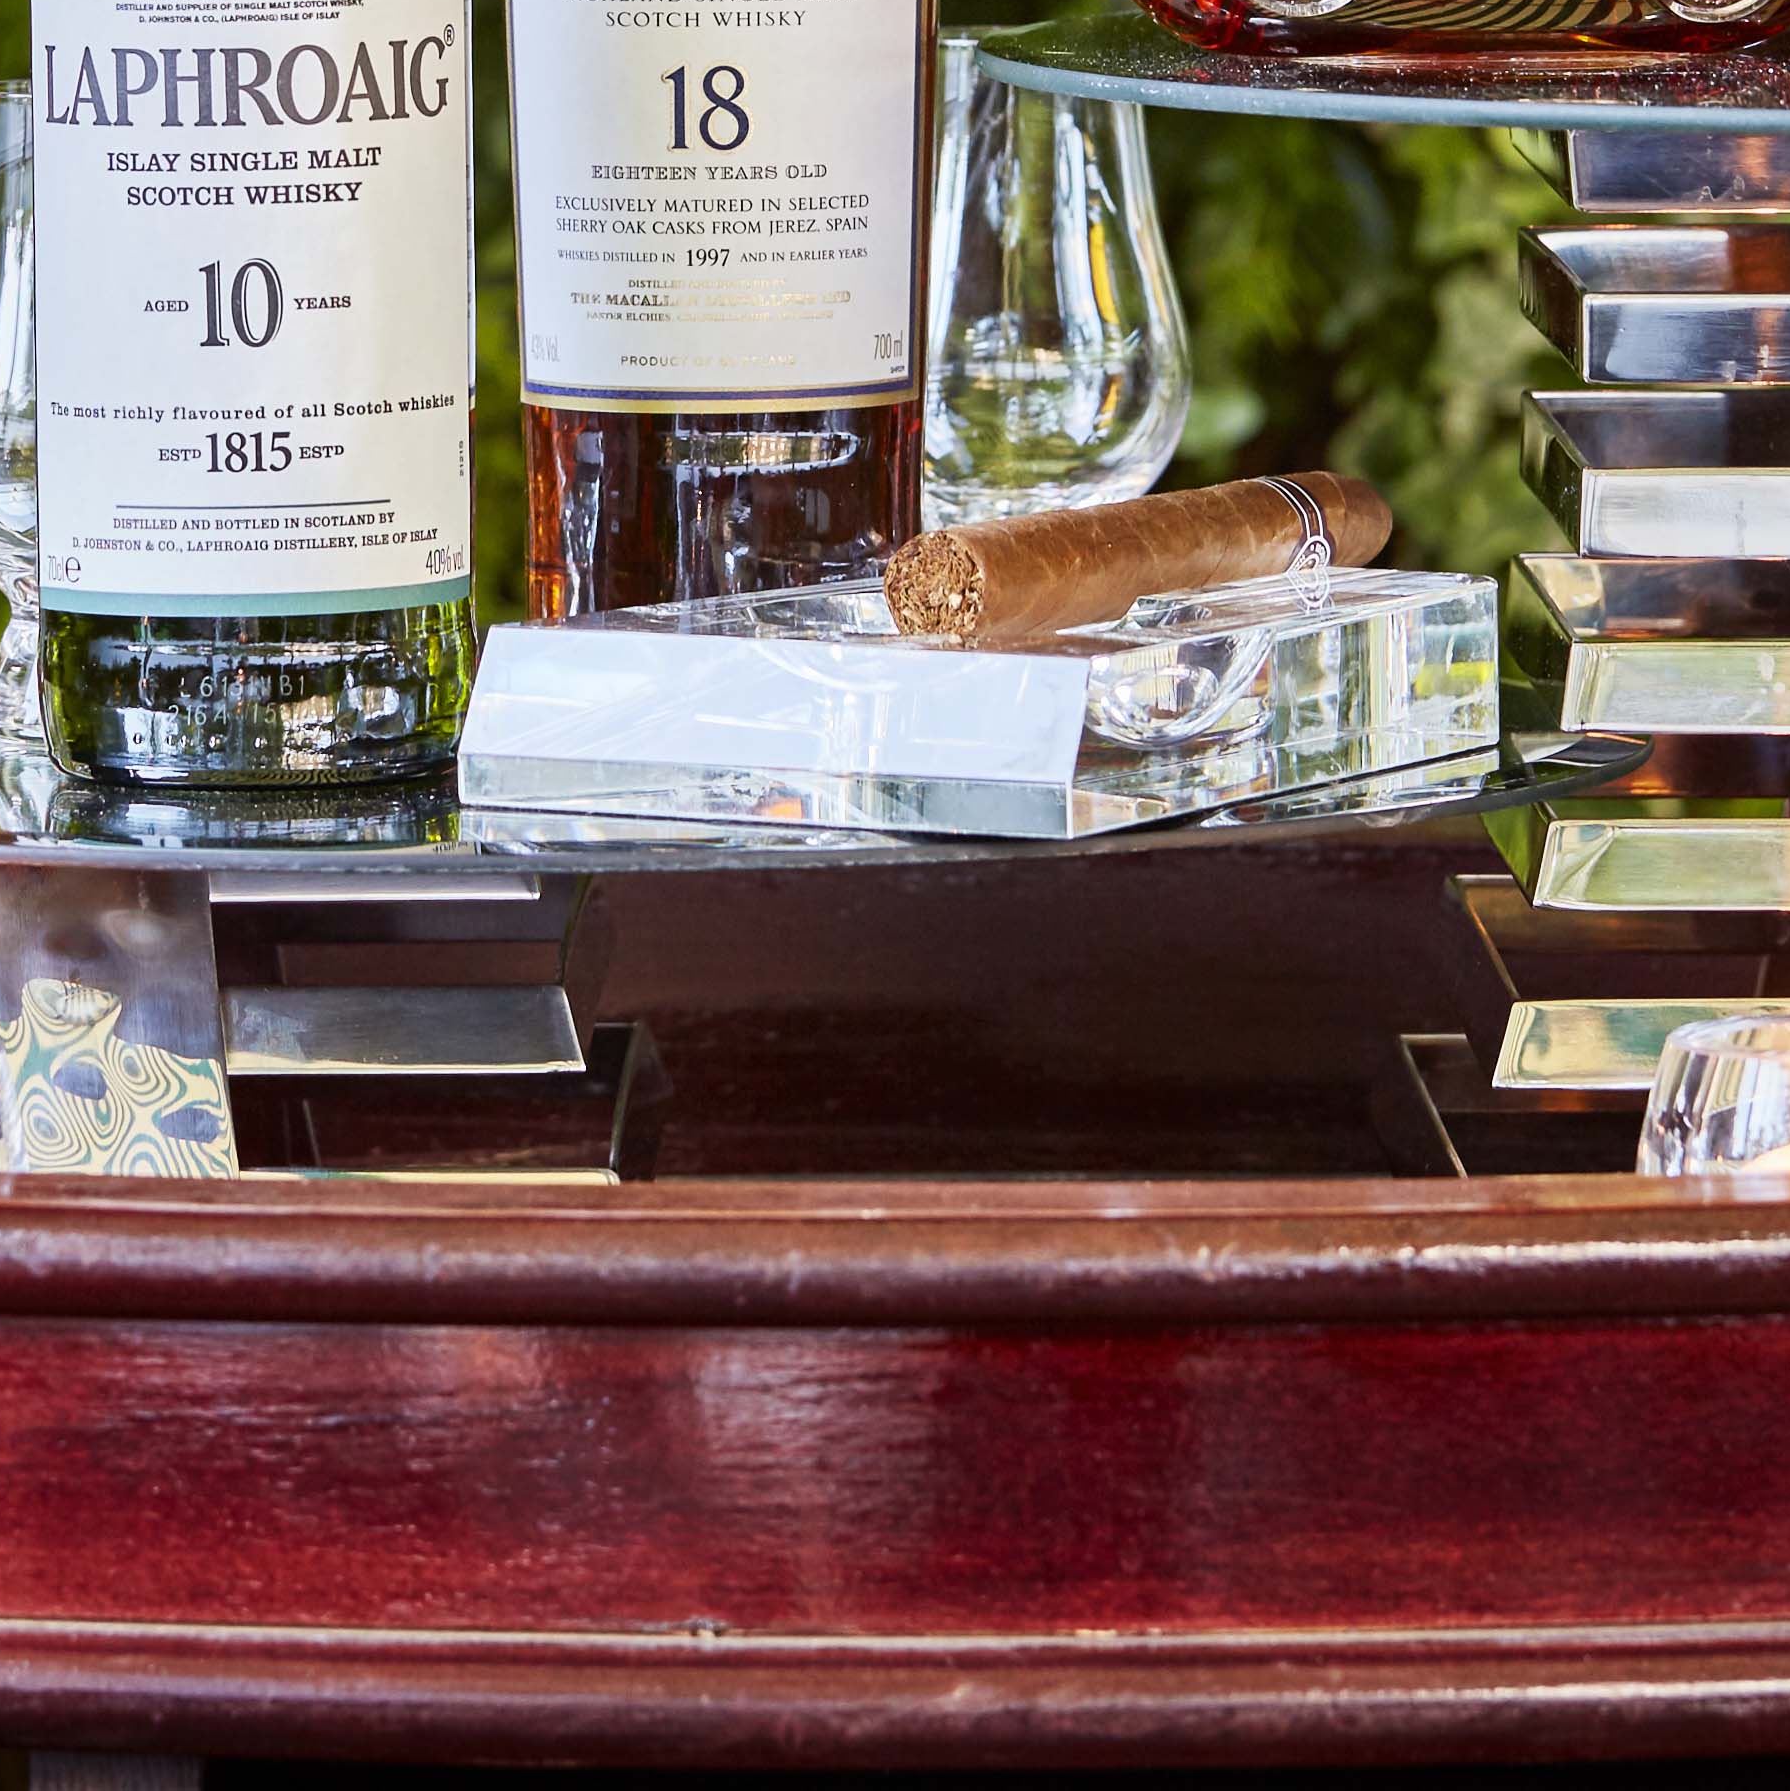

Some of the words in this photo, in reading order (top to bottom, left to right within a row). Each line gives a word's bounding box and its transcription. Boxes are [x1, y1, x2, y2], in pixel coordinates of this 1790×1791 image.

[116, 2, 154, 11] DISTILLER
[156, 3, 173, 11] AND
[176, 2, 217, 10] SUPPLIER
[220, 2, 232, 10] OF
[234, 2, 266, 10] SINGLE
[269, 1, 291, 9] MALT
[294, 0, 328, 8] SCOTCH
[149, 15, 192, 23] JOHNSTON
[280, 13, 299, 21] ISLE
[302, 12, 314, 20] OF
[316, 11, 340, 20] ISLAY
[605, 11, 701, 28] SCOTCH
[712, 10, 807, 28] WHISKY
[660, 64, 751, 152] 18
[106, 152, 180, 173] ISLAY
[190, 151, 298, 171] SINGLE
[308, 147, 382, 170] MALT
[591, 165, 698, 180] EIGHTEEN
[705, 165, 778, 180] YEARS
[785, 164, 828, 178] OLD
[126, 186, 235, 206] SCOTCH
[244, 181, 363, 205] WHISKY
[555, 195, 657, 213] EXCLUSIVELY
[664, 198, 753, 213] MATURED
[760, 198, 781, 211] IN
[788, 194, 869, 211] SELECTED
[555, 218, 607, 234] SHERRY
[612, 220, 646, 235] OAK
[652, 220, 705, 235] CASKS
[712, 220, 761, 235] FROM
[826, 215, 869, 231] SPAIN
[557, 249, 600, 261] WHISKIES
[602, 250, 658, 263] DISTILLED
[662, 252, 675, 263] IN
[686, 248, 730, 267] 1997
[740, 252, 767, 263] AND
[771, 251, 785, 261] IN
[789, 249, 835, 261] EARLIER
[838, 247, 868, 259] YEARS
[144, 299, 190, 314] AGED
[198, 257, 284, 349] 10
[293, 295, 352, 310] YEARS
[873, 333, 892, 360] 700
[51, 401, 69, 417] The
[73, 405, 106, 419] most
[112, 406, 165, 423] richly
[172, 405, 267, 421] flavoured
[274, 403, 295, 419] of
[301, 402, 327, 418] all
[333, 400, 393, 417] Scotch
[397, 392, 455, 413] whiskies
[158, 446, 202, 463] ESTD
[205, 430, 293, 474] 1815
[298, 443, 345, 460] ESTD
[112, 517, 178, 531] DISTILLED
[181, 517, 211, 531] AND
[215, 516, 280, 530] BOTTLED
[284, 516, 301, 529] IN
[304, 513, 376, 528] SCOTLAND
[378, 511, 396, 525] BY
[83, 537, 142, 552] JOHNSTON
[145, 539, 155, 552] &
[187, 538, 270, 553] LAPHROAIG
[273, 535, 358, 553] DISTILLERY,
[361, 532, 390, 547] ISLE
[392, 531, 408, 545] OF
[409, 528, 439, 543] ISLAY
[425, 550, 452, 576] 40%
